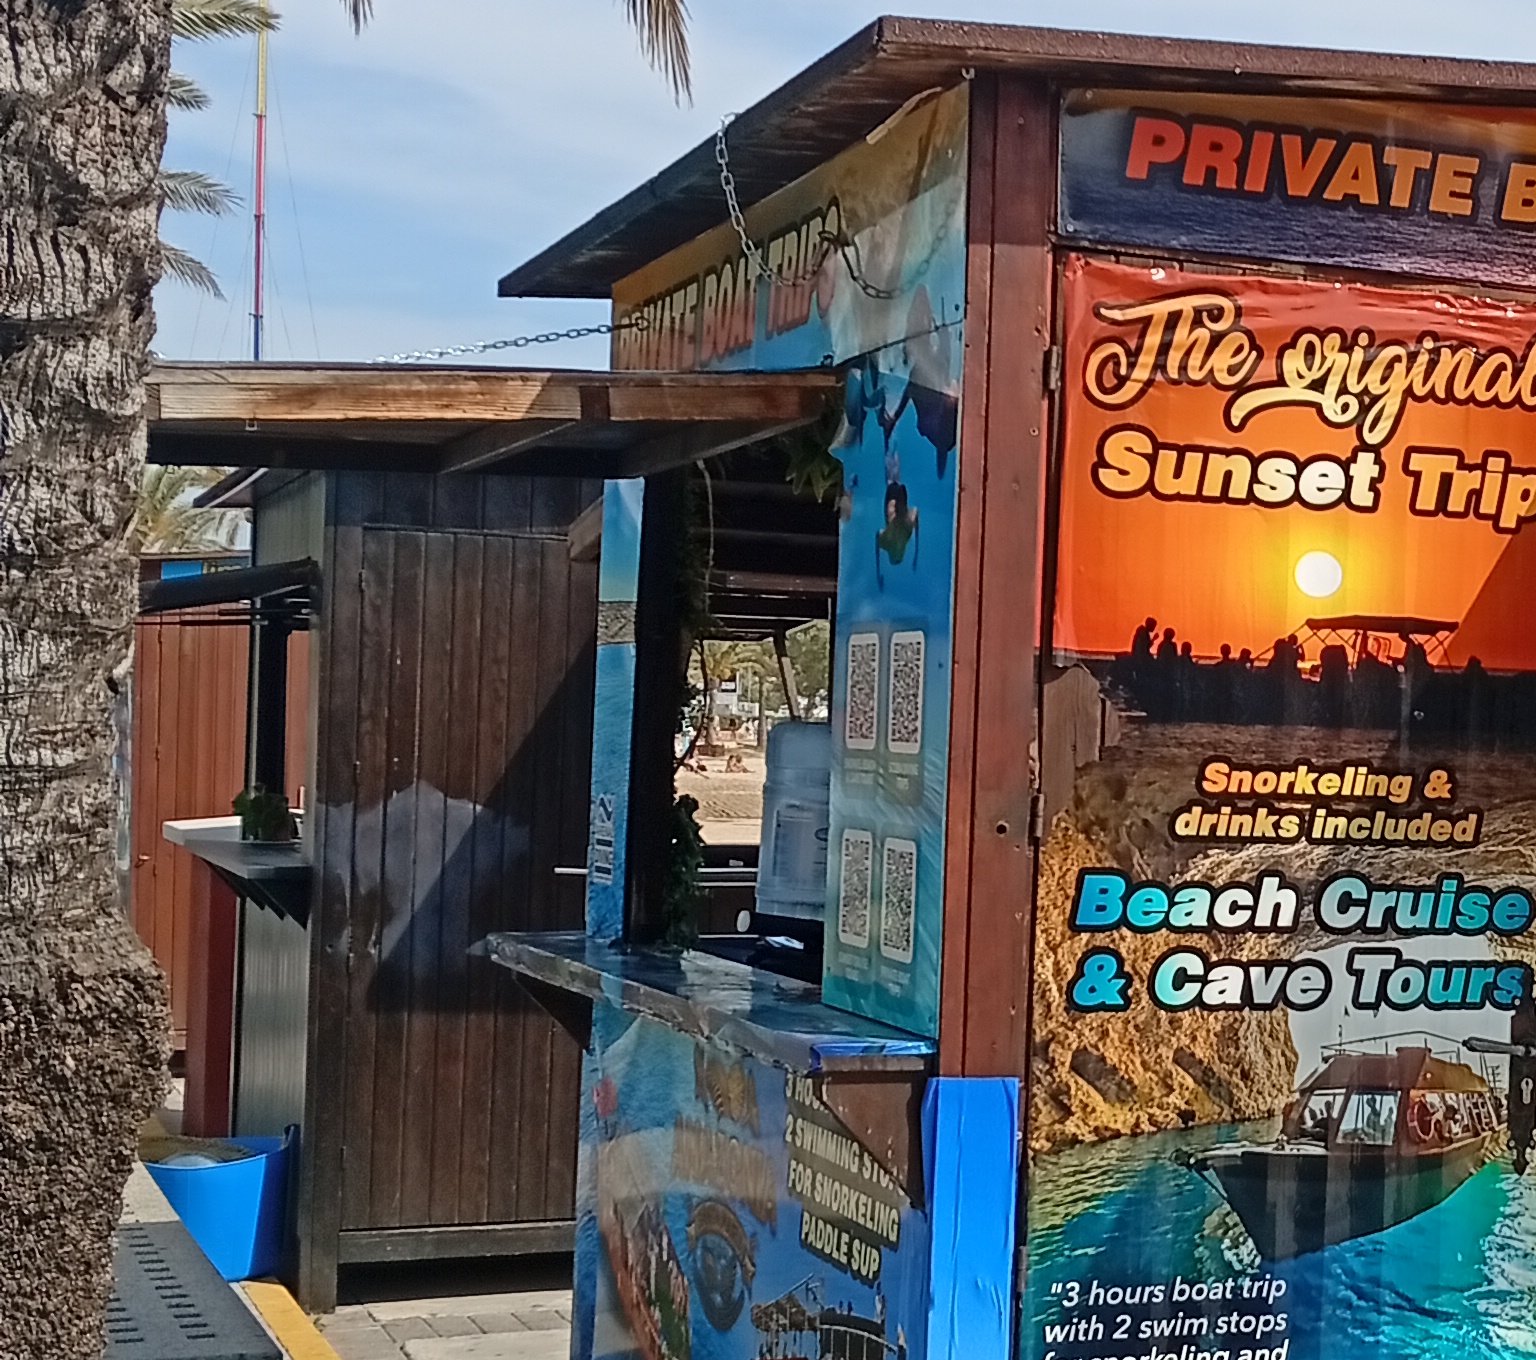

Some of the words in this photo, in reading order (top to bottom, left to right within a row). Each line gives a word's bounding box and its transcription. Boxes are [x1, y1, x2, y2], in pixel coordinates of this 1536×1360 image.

[1126, 118, 1481, 216] PRIVATE
[618, 282, 698, 371] PRIVATE
[702, 249, 763, 362] BOAT
[766, 205, 839, 340] TRIPS
[1085, 292, 1261, 404] The
[1098, 431, 1381, 507] Sunset
[1202, 762, 1413, 803] Snorkeling
[1424, 769, 1453, 798] &
[1175, 806, 1300, 838] drinks
[1312, 808, 1478, 842] included
[1075, 874, 1298, 928] Beach
[1319, 877, 1531, 931] Cruise
[1073, 952, 1128, 1006] &
[1154, 952, 1327, 1007] Cave
[1351, 953, 1527, 1006] Tours
[785, 1114, 794, 1143] 2
[796, 1118, 860, 1174] SWIMMING
[788, 1159, 812, 1197] FOR
[814, 1172, 899, 1244] SNORKELING
[801, 1211, 850, 1265] PADDLE
[851, 1238, 881, 1280] SUP
[1050, 1281, 1081, 1308] "3
[1088, 1280, 1165, 1307] hours
[1172, 1275, 1235, 1303] boat
[1242, 1273, 1288, 1305] trip
[1044, 1314, 1105, 1343] with
[1112, 1314, 1133, 1340] 2
[1138, 1312, 1209, 1340] swim
[1215, 1311, 1289, 1340] stops
